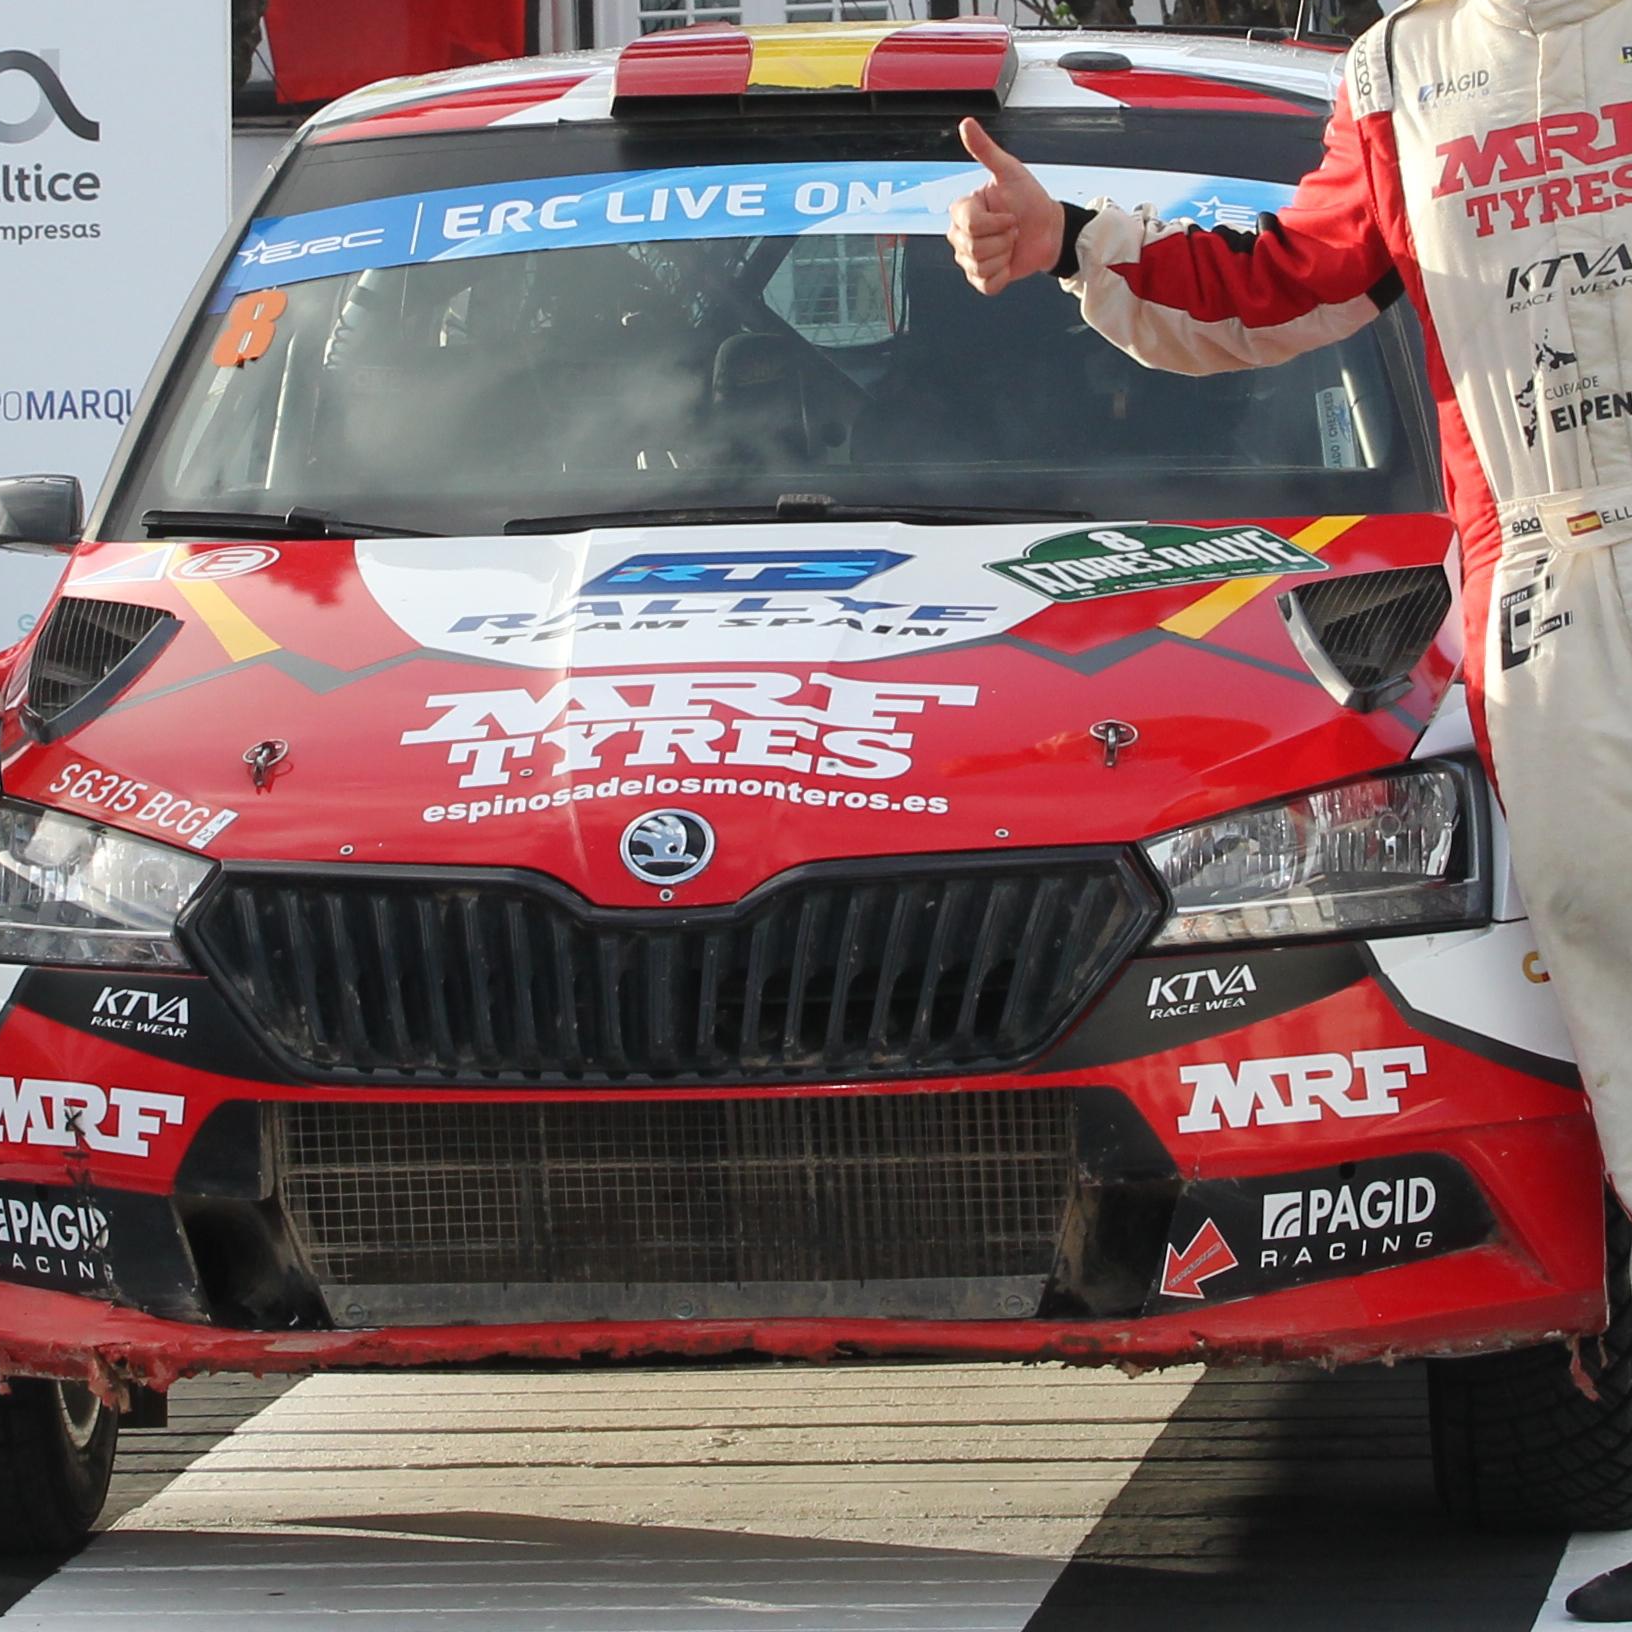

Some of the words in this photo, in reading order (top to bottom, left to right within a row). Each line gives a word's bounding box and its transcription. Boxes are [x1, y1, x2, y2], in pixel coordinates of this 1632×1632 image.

[1435, 70, 1489, 98] PAGID
[442, 194, 579, 240] ERC
[605, 182, 766, 225] LIVE
[794, 180, 894, 215] ON
[260, 228, 385, 264] ERC
[1509, 293, 1556, 314] RACE
[211, 287, 289, 368] 8
[1007, 547, 1166, 595] AZORES
[1161, 529, 1310, 569] RALLYE
[1087, 530, 1146, 553] 8
[607, 560, 877, 584] RTS
[447, 595, 998, 633] RALLYE
[483, 619, 686, 645] TEAM
[717, 616, 948, 637] SPAIN
[400, 670, 980, 746] MRF
[446, 717, 915, 790] TYRES
[422, 773, 949, 825] espinosadelosmonteros.es
[91, 986, 191, 1027] KTVA
[1146, 964, 1257, 1008] KTVA
[90, 1016, 134, 1031] RACE
[136, 1022, 188, 1039] WEAR
[1150, 1001, 1201, 1020] RACE
[1177, 1045, 1428, 1135] MRF
[7, 1198, 109, 1250] PAGID
[1307, 1176, 1437, 1235] PAGID
[1260, 1230, 1434, 1268] RACING
